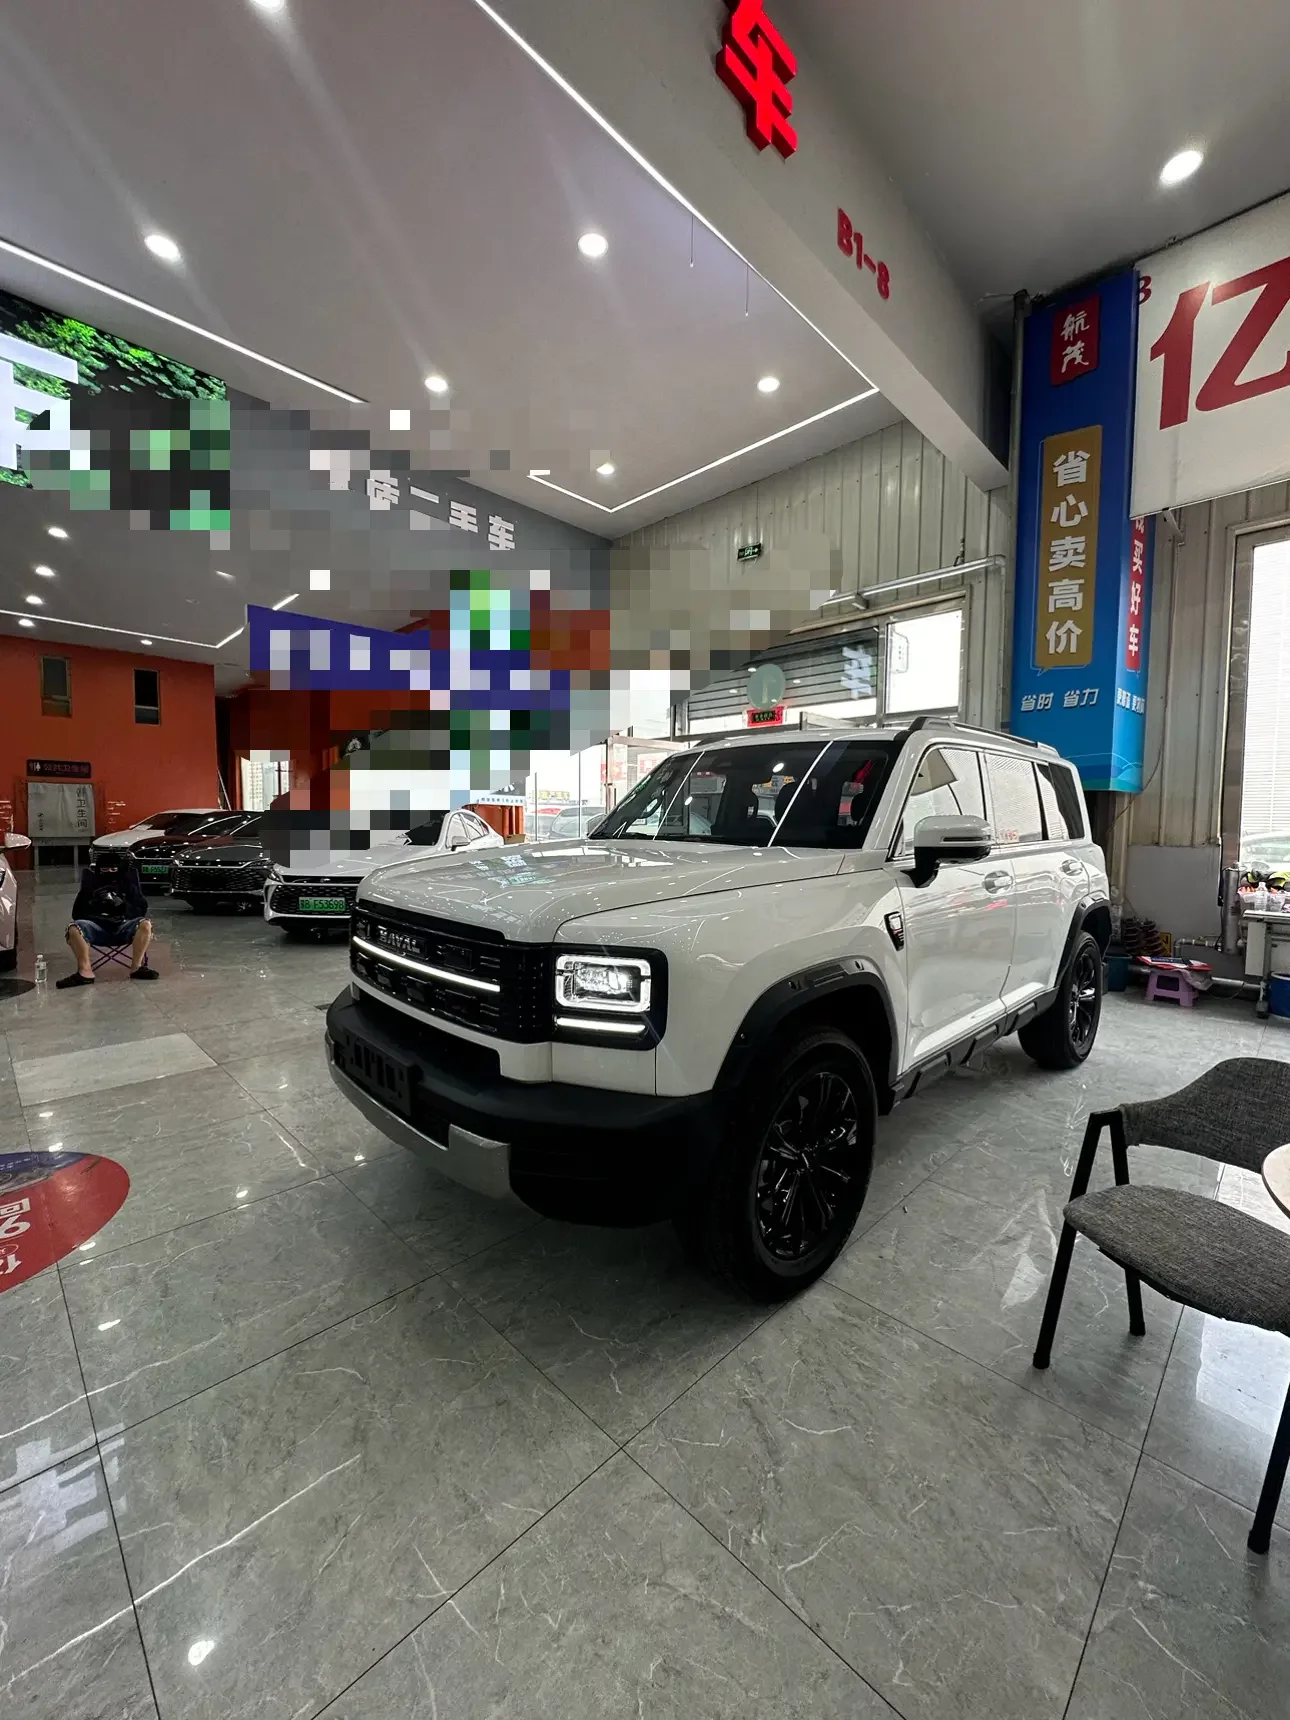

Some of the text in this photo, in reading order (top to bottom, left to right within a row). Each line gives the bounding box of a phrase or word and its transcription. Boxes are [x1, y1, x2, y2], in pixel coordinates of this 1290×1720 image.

[837, 207, 891, 300] B1-8
[1060, 310, 1090, 373] 航茂
[1046, 449, 1091, 655] 省心卖高价
[1020, 691, 1054, 712] 省时
[1063, 688, 1100, 708] 省力
